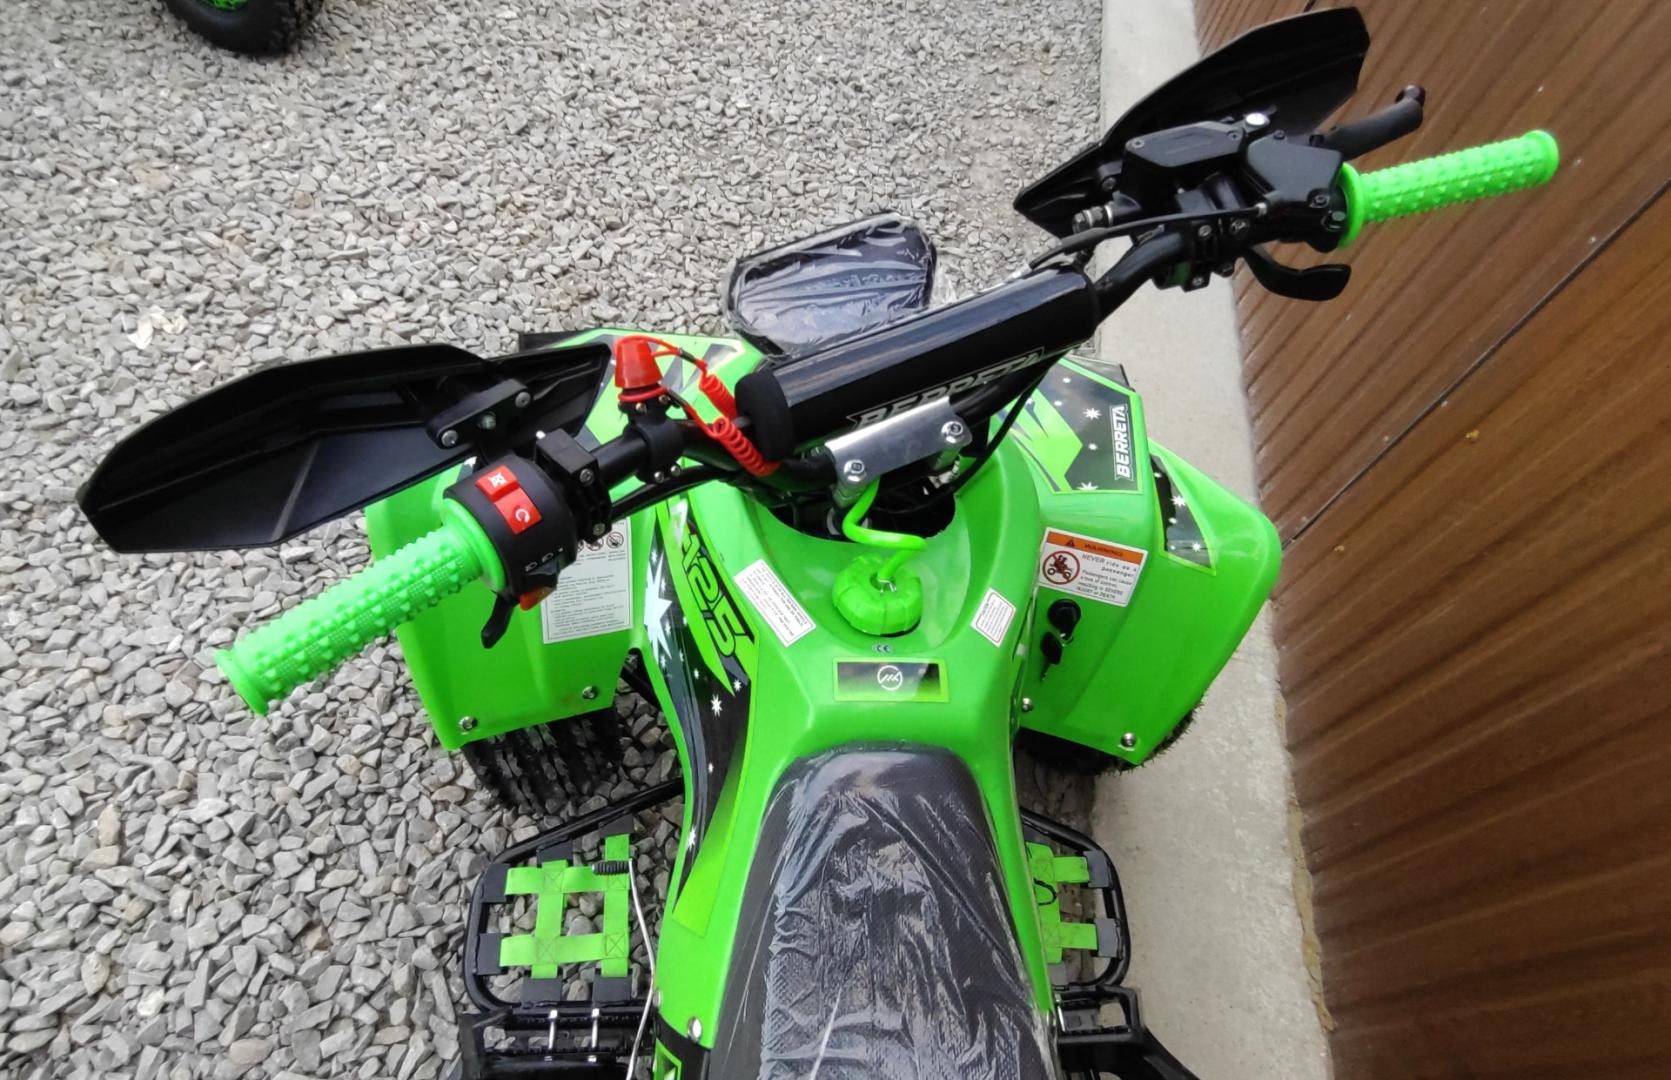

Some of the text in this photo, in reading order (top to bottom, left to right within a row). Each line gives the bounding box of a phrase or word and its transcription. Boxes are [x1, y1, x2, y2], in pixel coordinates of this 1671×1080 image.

[1111, 405, 1131, 478] BERRETA
[1082, 554, 1105, 564] NEVER
[1101, 566, 1133, 577] passenger
[682, 533, 747, 657] 125
